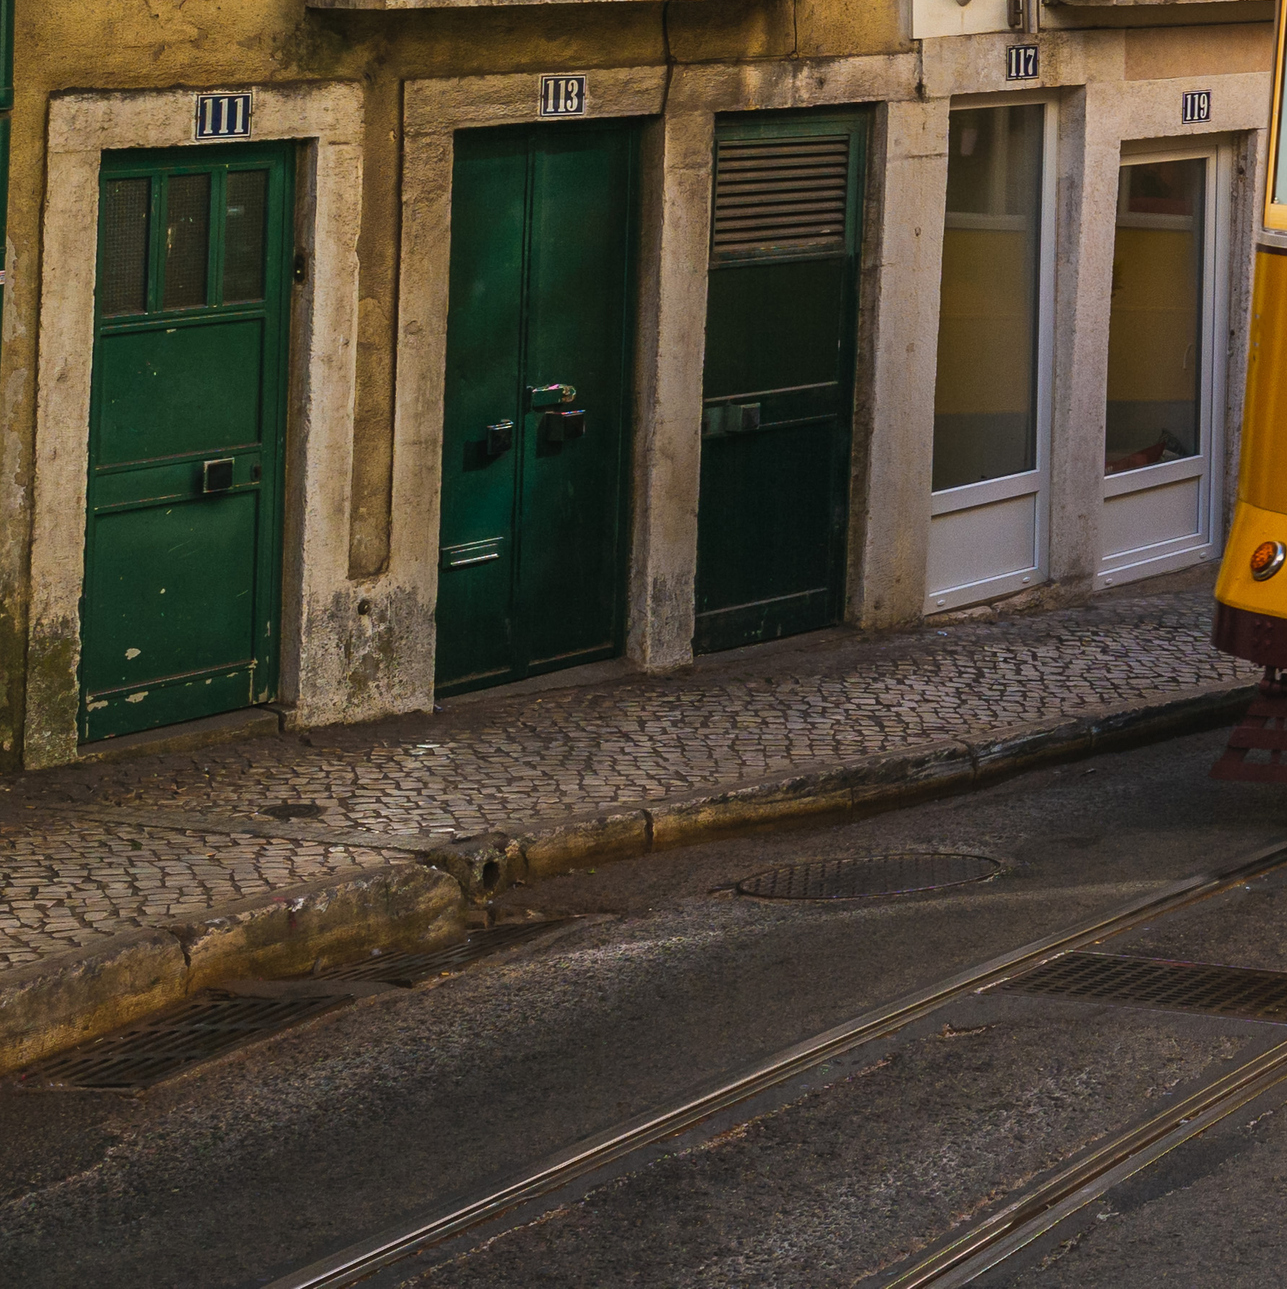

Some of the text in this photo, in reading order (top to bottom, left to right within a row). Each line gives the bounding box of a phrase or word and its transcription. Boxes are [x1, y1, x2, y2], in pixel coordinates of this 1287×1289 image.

[1009, 48, 1036, 77] 117
[546, 79, 579, 112] 113
[1185, 94, 1208, 121] 119
[203, 97, 244, 134] 111
